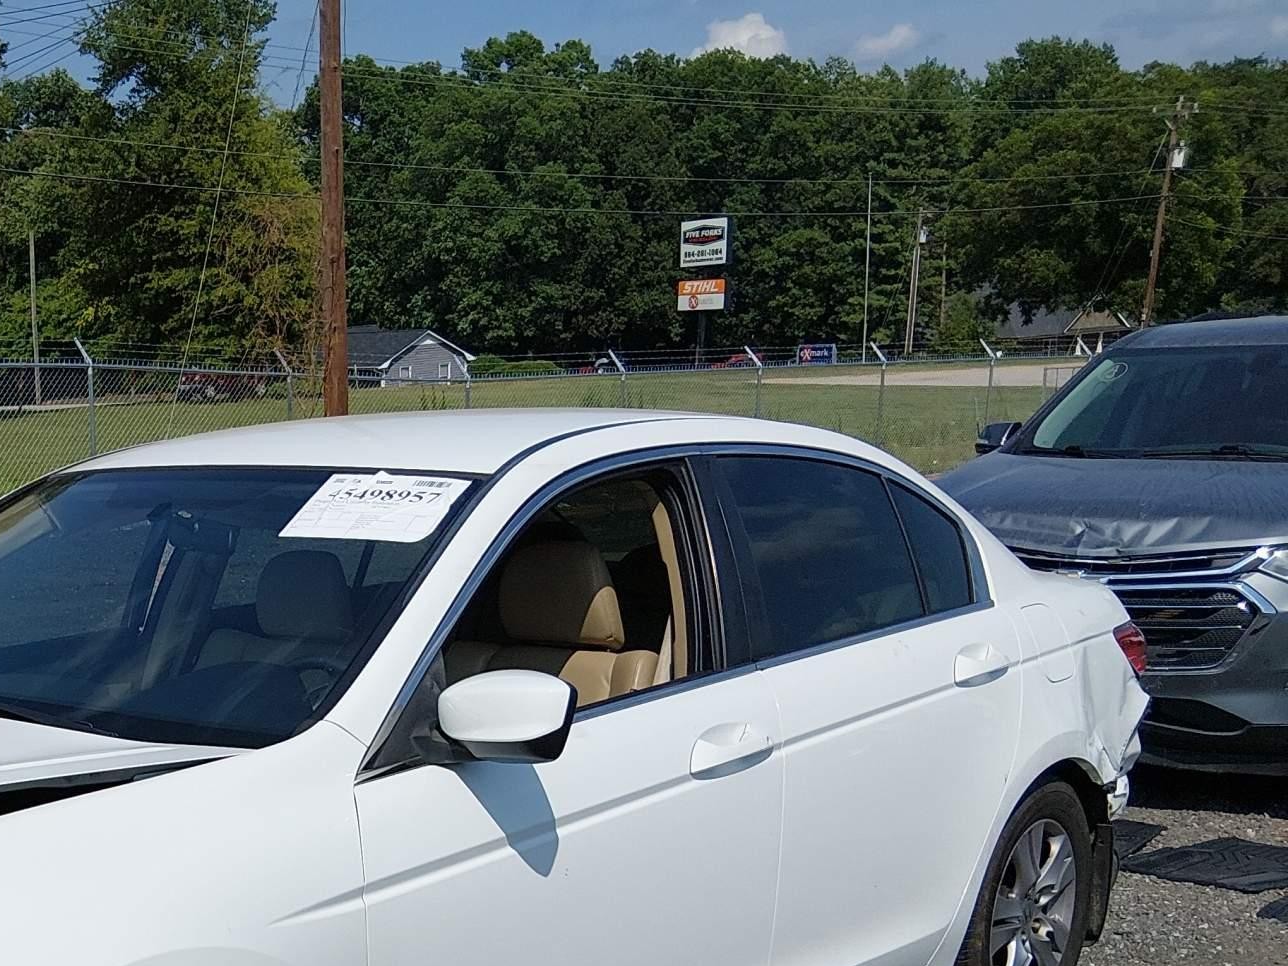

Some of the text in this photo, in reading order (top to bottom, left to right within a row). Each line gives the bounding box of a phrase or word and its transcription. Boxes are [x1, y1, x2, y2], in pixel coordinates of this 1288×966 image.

[685, 228, 723, 239] FIVE FORKS
[682, 280, 719, 294] STIHL
[328, 488, 443, 504] 45498957
